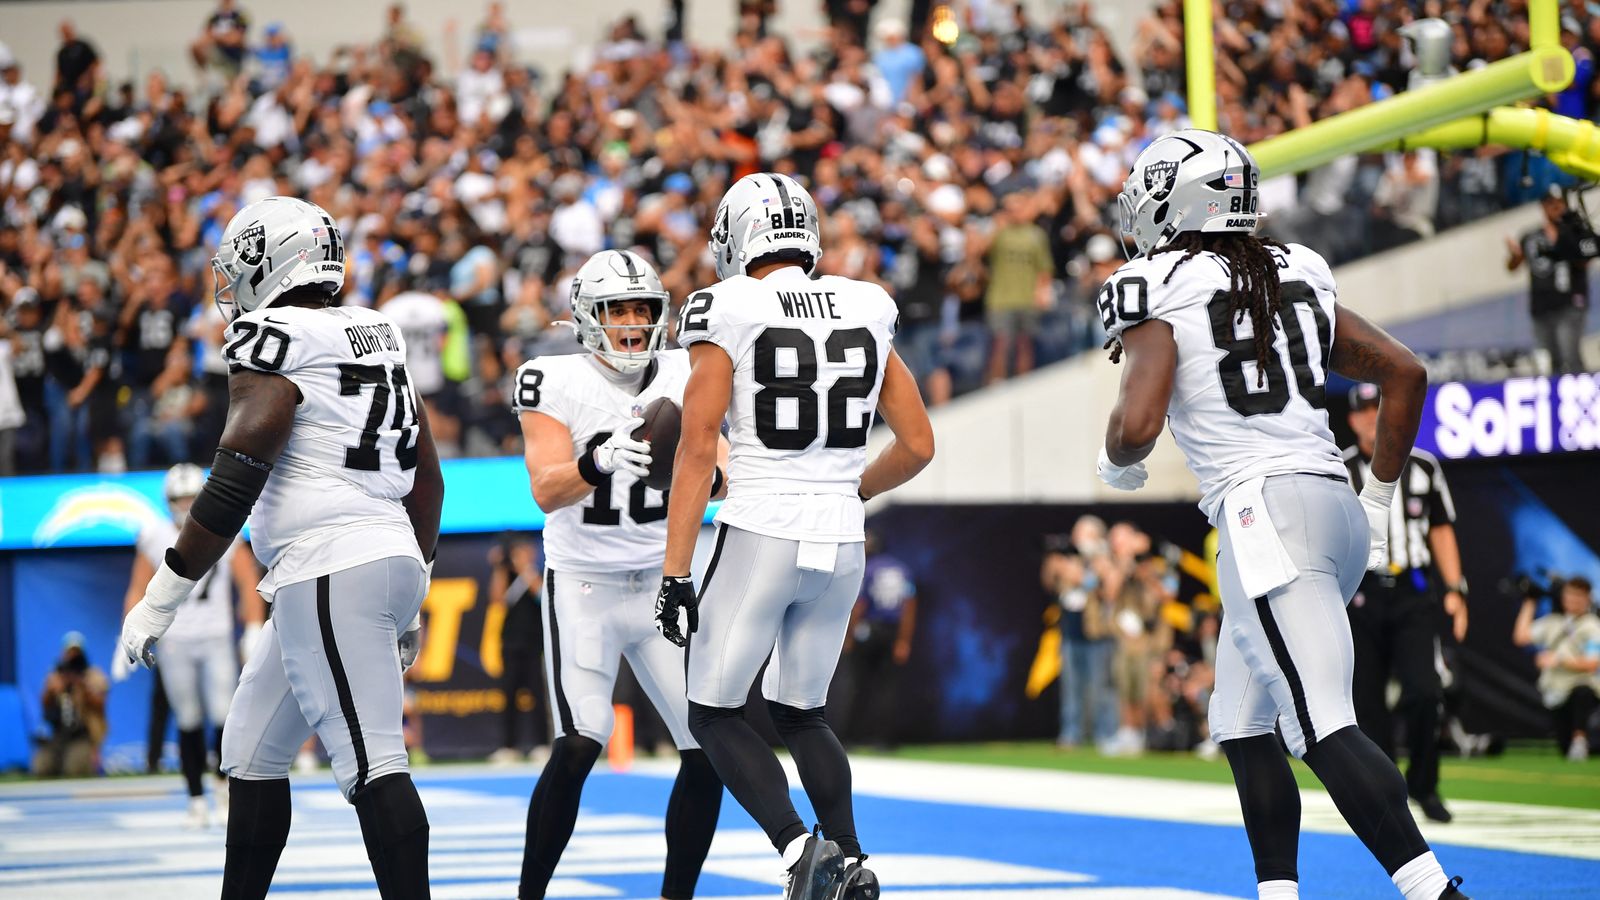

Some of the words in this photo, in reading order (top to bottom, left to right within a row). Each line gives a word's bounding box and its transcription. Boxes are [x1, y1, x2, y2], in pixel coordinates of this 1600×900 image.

[771, 213, 805, 229] 82
[1226, 219, 1256, 227] RAIDERS
[1230, 196, 1257, 213] 80
[774, 231, 805, 239] RAIDERS
[322, 264, 343, 273] RAIDERS
[776, 291, 841, 319] WHITE
[1098, 276, 1148, 331] 80
[226, 321, 290, 370] 70
[344, 322, 400, 359] BURFORD
[1207, 281, 1331, 417] 80
[754, 327, 878, 450] 82
[337, 364, 419, 472] 70
[1434, 375, 1553, 459] SoFi
